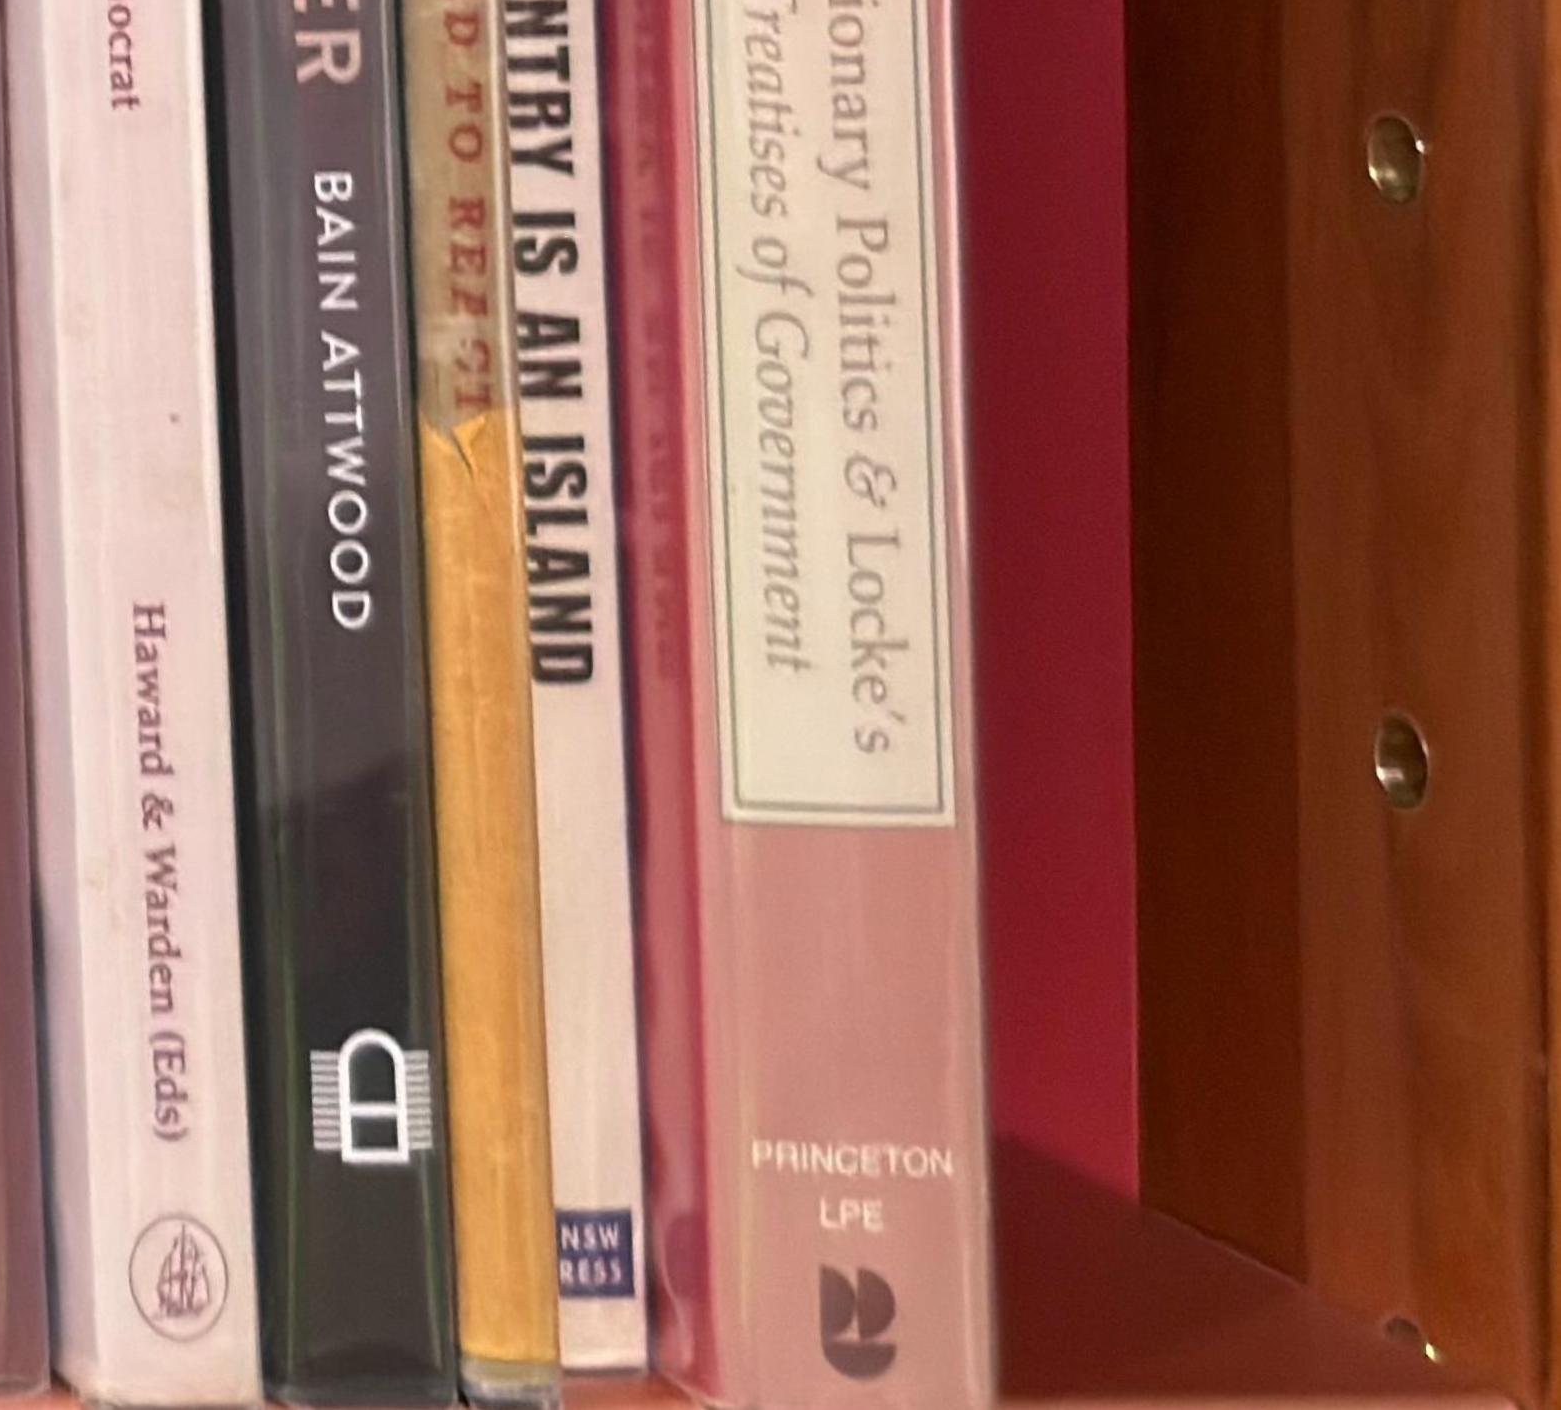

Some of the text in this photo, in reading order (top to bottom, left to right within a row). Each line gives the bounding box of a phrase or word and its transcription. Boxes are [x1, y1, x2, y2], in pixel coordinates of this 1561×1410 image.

[515, 212, 578, 276] IS
[836, 216, 895, 433] Politics
[314, 171, 372, 629] BAIN ATTWOOD
[754, 315, 810, 675] Government
[522, 435, 593, 684] ISLAND
[132, 602, 189, 1143] Haward Warden (Eds)
[752, 1139, 955, 1177] PRINCETON
[819, 1199, 883, 1231] LPE
